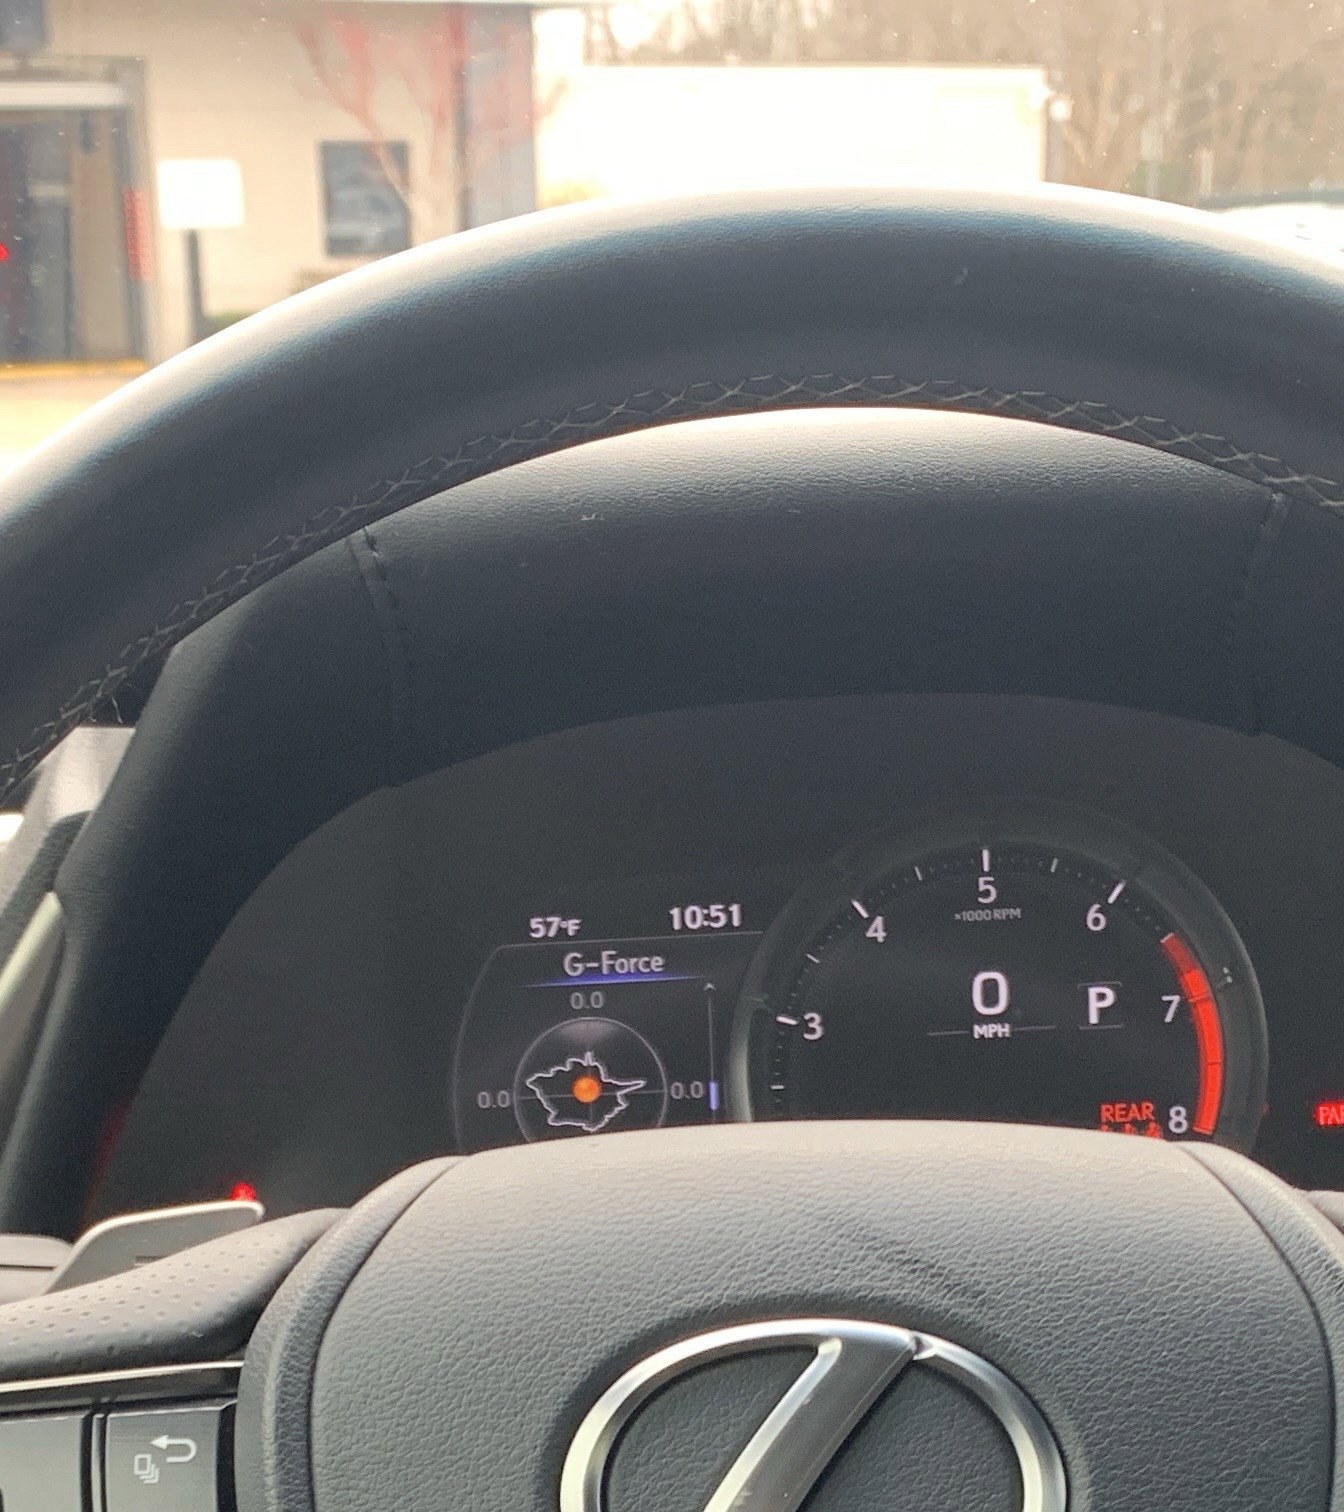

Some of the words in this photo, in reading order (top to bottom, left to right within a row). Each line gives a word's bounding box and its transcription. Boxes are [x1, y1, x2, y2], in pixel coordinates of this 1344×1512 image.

[978, 877, 996, 903] 5
[670, 904, 740, 930] 10:51
[993, 907, 1021, 919] RPM
[1087, 904, 1106, 931] 6
[865, 915, 887, 942] 4
[564, 951, 664, 974] G-Force
[570, 991, 605, 1009] 0.0
[973, 971, 1008, 1015] 0
[1088, 987, 1114, 1024] P
[1162, 995, 1180, 1022] 7
[804, 1013, 823, 1040] 3
[974, 1023, 1009, 1038] MPH
[478, 1090, 510, 1108] 0.0
[670, 1081, 704, 1101] 0.0
[1101, 1104, 1155, 1122] REAR
[1169, 1106, 1188, 1133] 8
